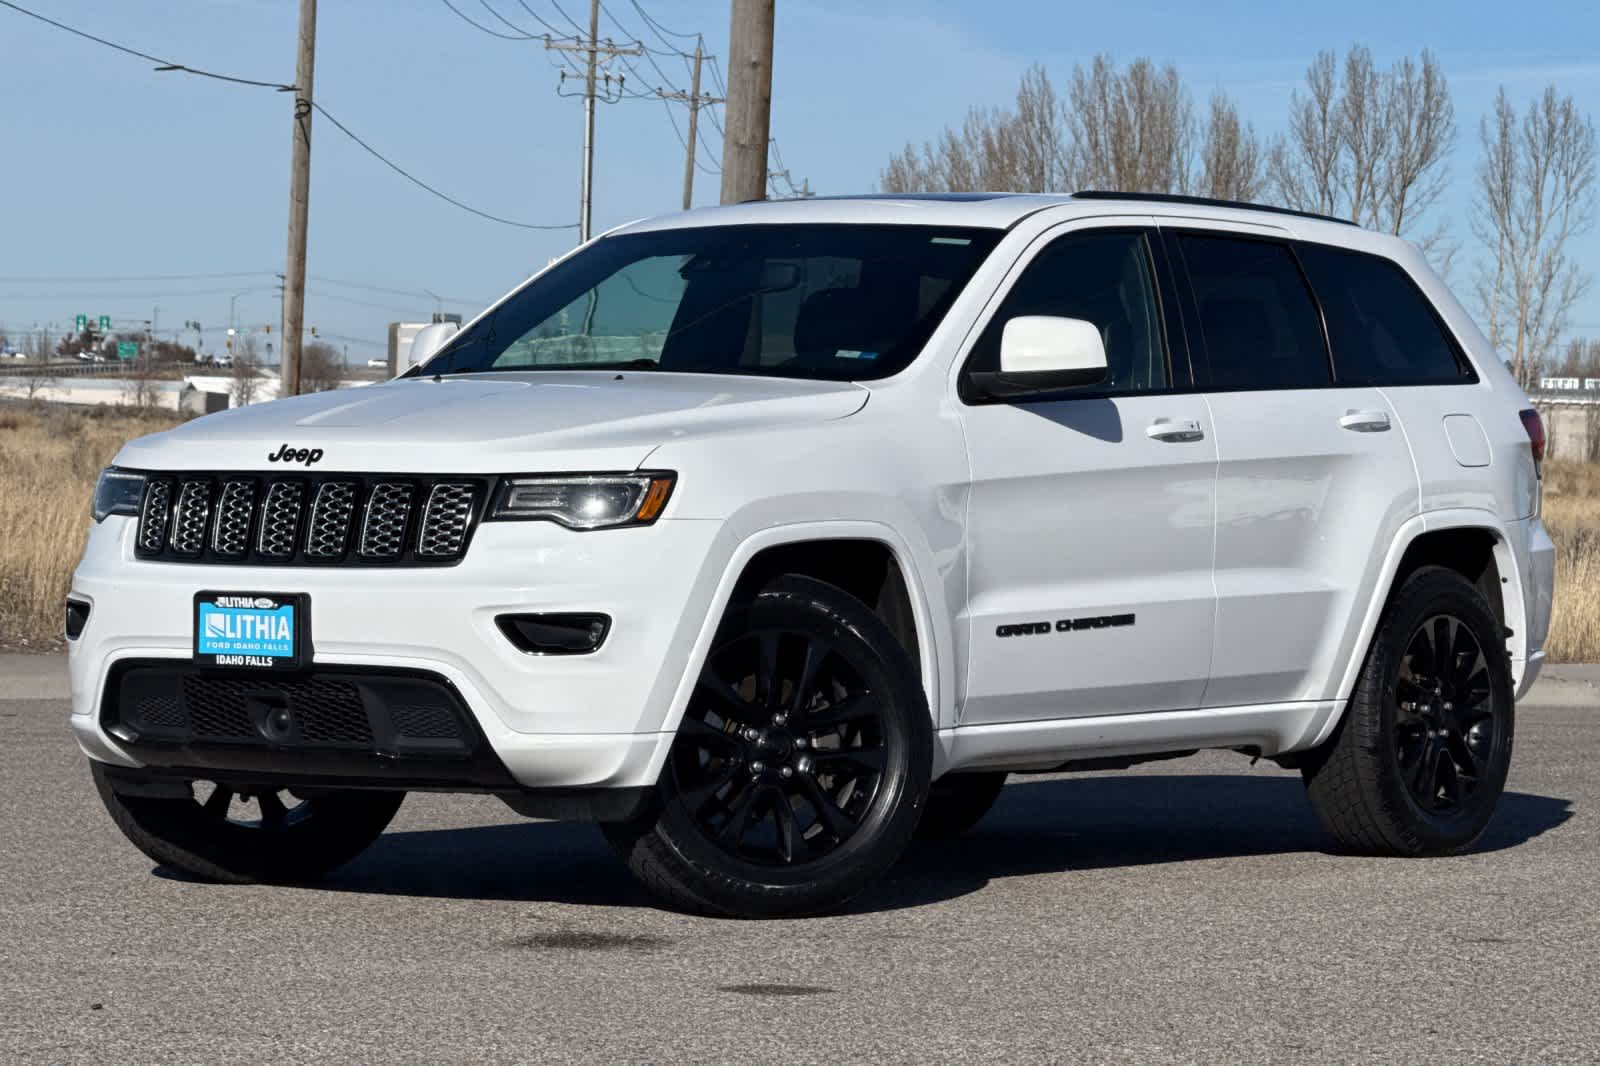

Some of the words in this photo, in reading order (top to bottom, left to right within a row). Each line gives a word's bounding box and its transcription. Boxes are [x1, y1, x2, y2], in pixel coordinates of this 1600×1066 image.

[268, 443, 324, 466] Jeep
[226, 597, 254, 608] LITHIA
[225, 614, 290, 640] LITHIA
[1055, 613, 1135, 632] CHEROE
[206, 641, 230, 650] FORD
[233, 642, 260, 651] IDAHO
[263, 643, 289, 651] FALLS
[216, 655, 244, 665] IDAHO
[245, 656, 273, 667] FALLS
